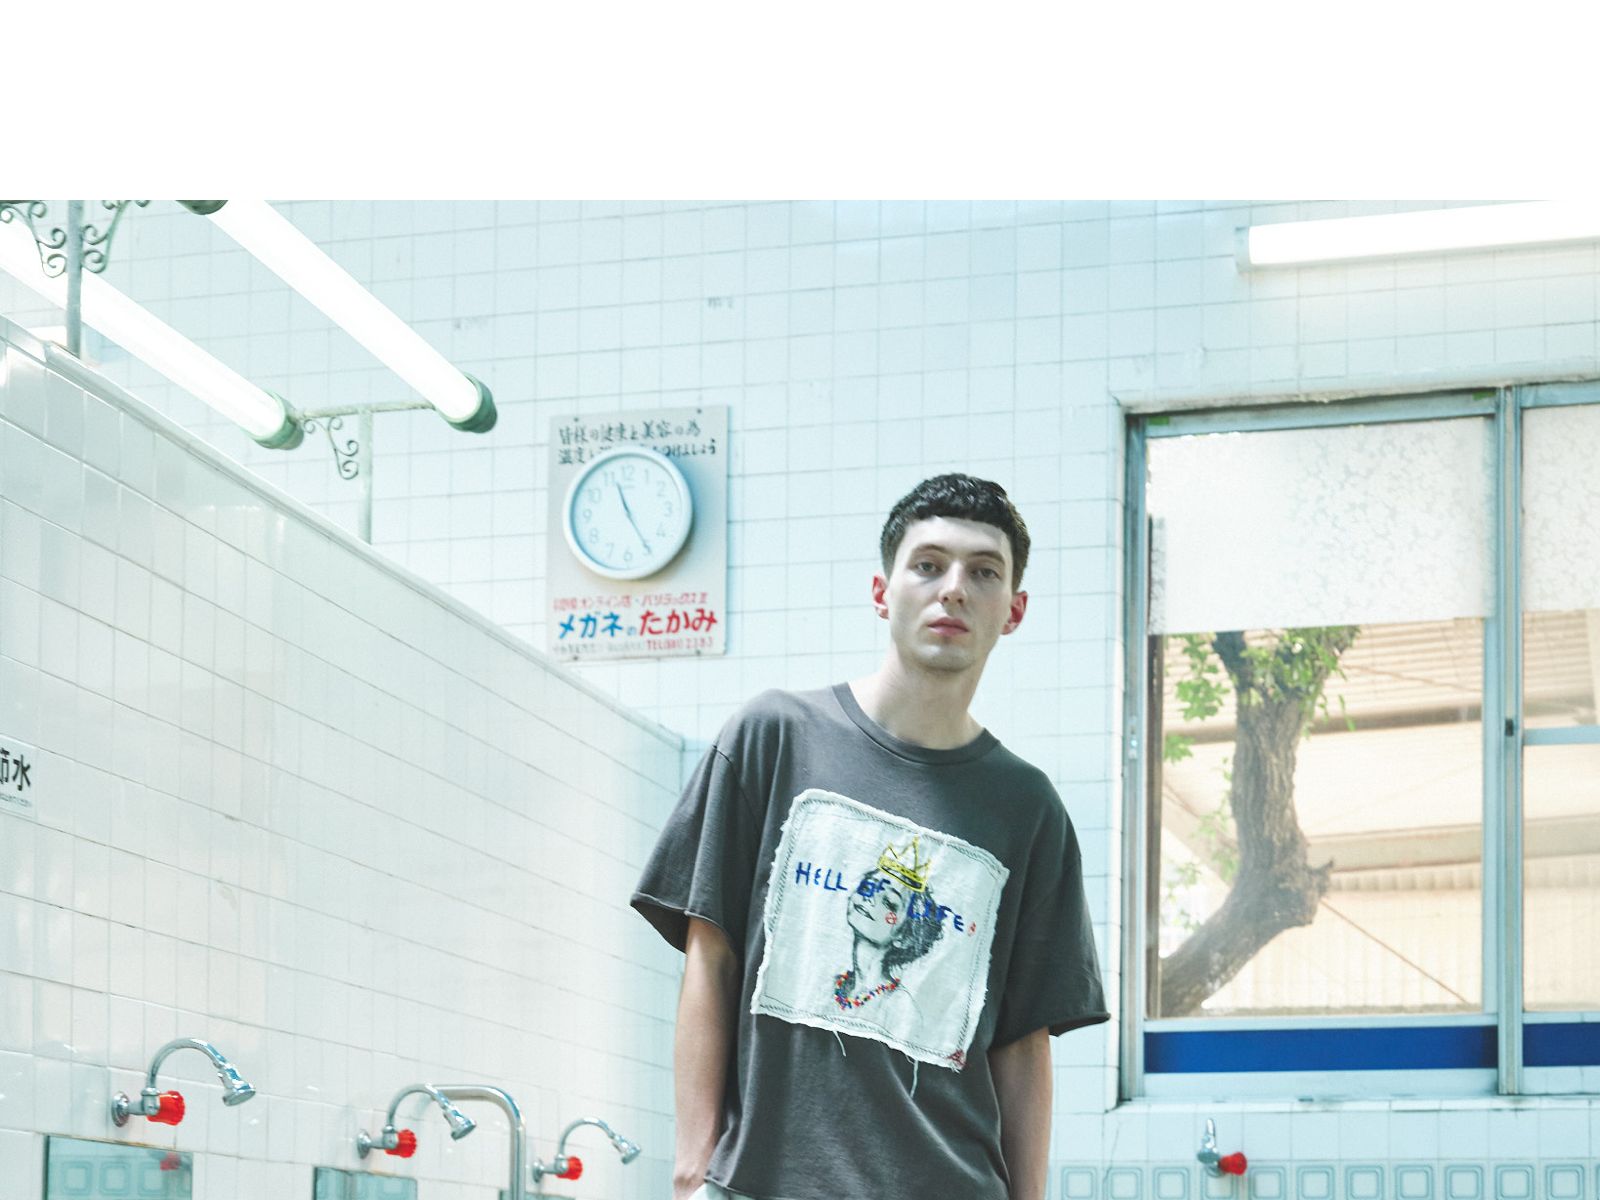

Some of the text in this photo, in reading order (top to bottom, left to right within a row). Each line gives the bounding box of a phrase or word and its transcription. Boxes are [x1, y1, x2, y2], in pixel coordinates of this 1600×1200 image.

[559, 608, 718, 639] メガネのたかみ
[796, 862, 848, 891] HELL
